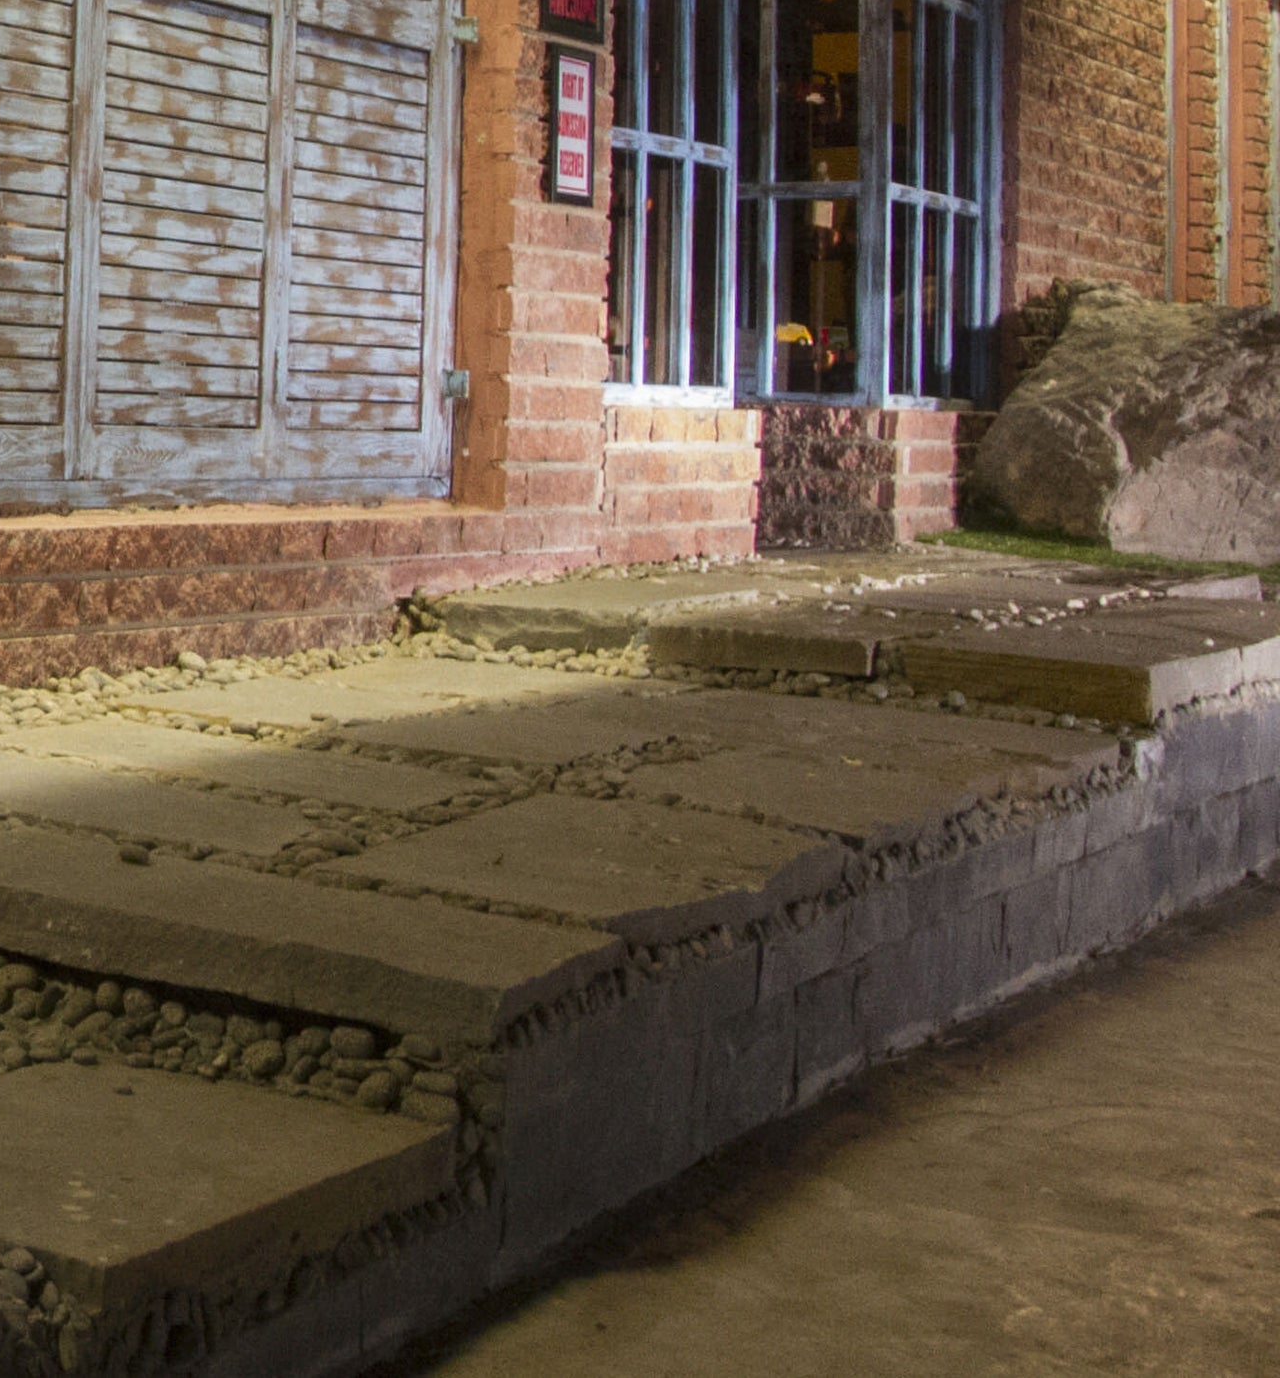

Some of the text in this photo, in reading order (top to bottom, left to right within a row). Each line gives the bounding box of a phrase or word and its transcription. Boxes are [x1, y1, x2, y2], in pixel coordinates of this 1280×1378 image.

[562, 72, 584, 101] RIGHT OF
[558, 110, 586, 140] ADMISSION
[559, 149, 584, 178] RESERVED
